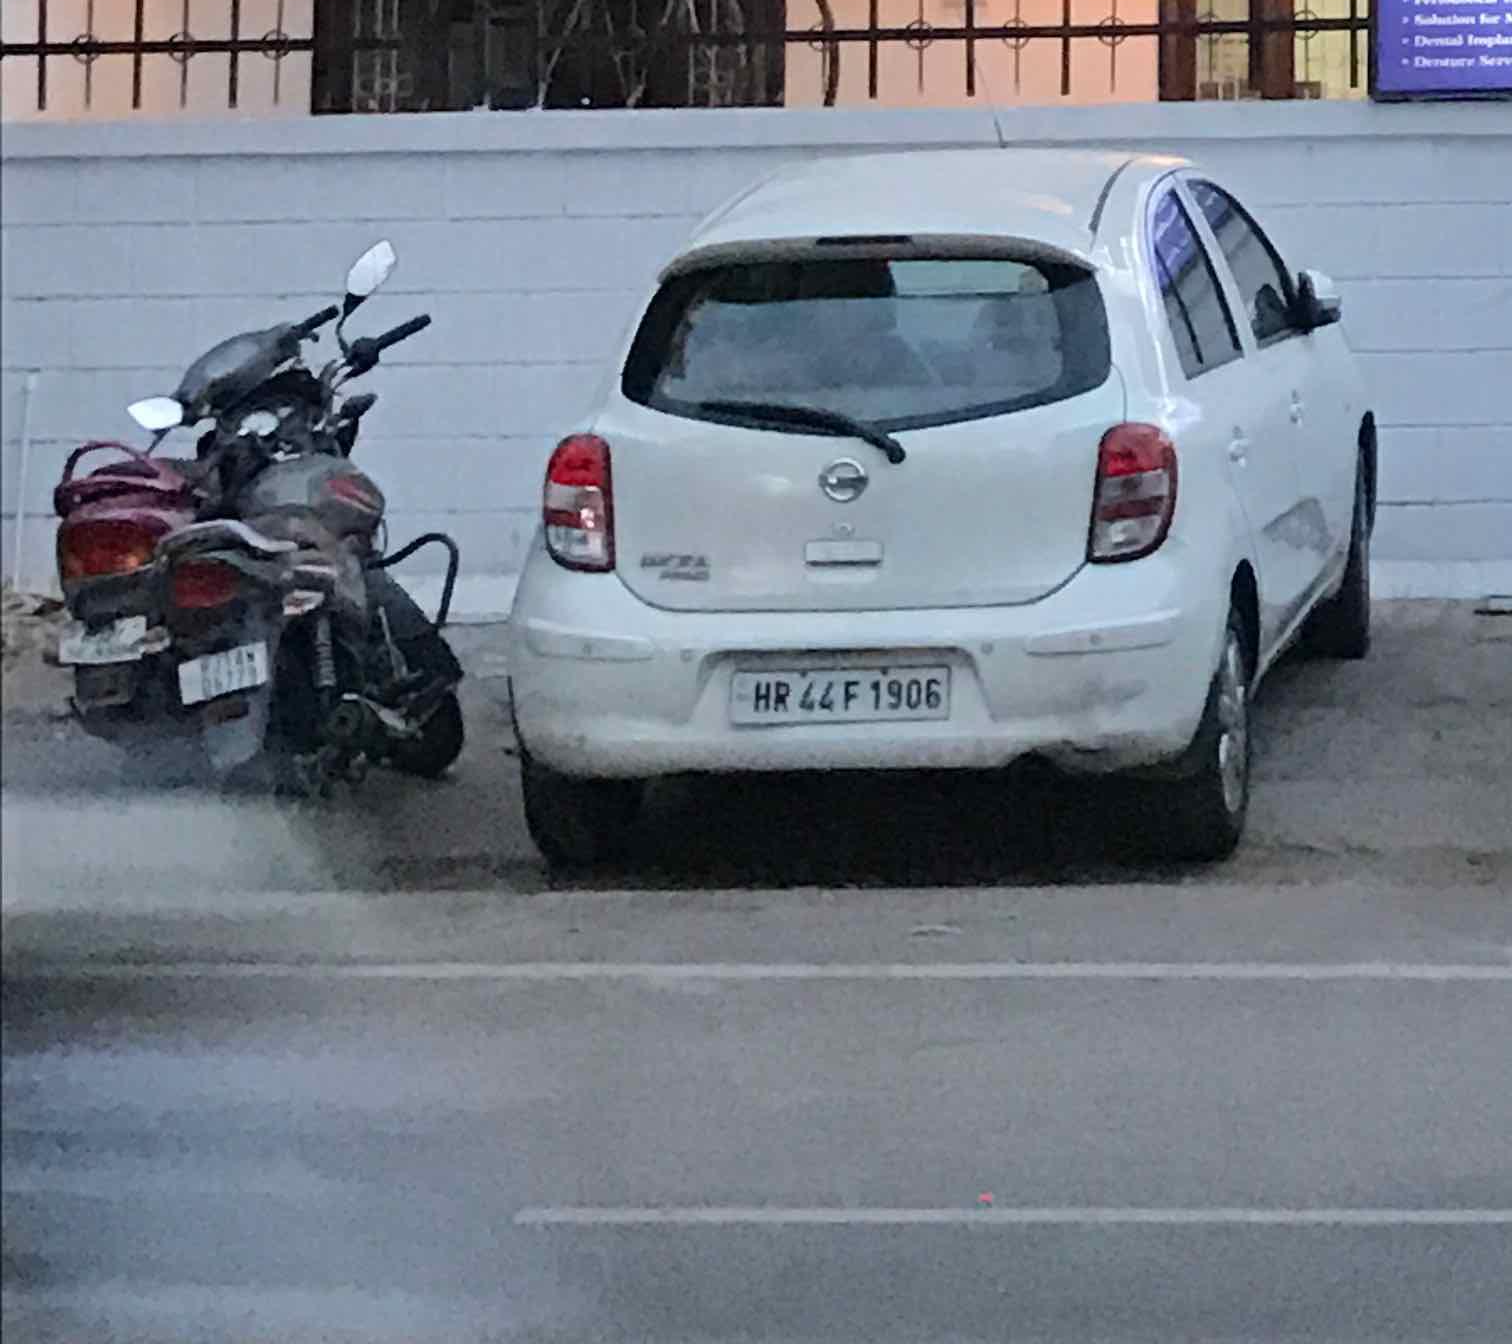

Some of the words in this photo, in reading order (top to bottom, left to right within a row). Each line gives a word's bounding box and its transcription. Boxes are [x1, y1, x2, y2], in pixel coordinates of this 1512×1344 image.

[1480, 12, 1499, 24] for
[1414, 35, 1464, 47] Dental
[753, 680, 790, 712] HR
[870, 678, 942, 711] 1906
